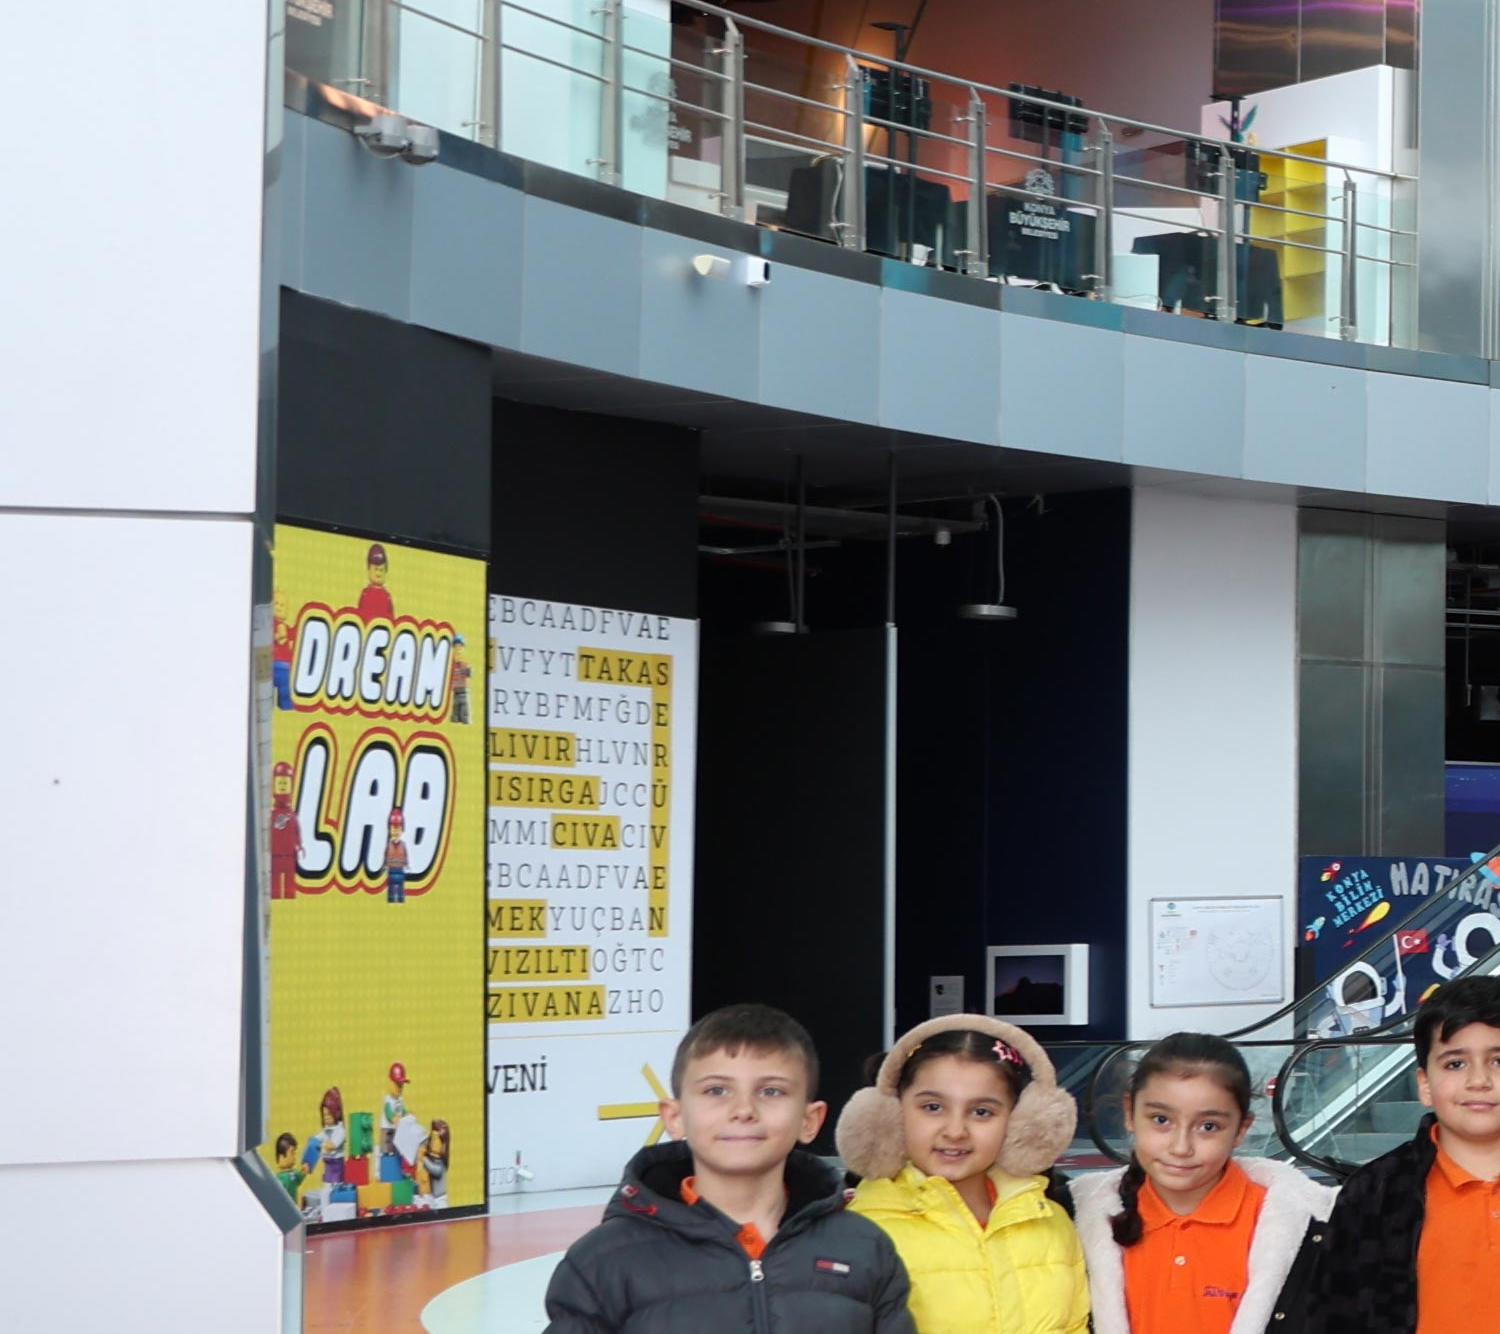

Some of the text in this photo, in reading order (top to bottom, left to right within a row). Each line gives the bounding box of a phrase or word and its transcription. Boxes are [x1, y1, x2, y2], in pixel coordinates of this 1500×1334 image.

[293, 615, 451, 713] DREAM
[296, 736, 449, 880] LAB
[1325, 869, 1369, 902] KONYA
[488, 1055, 547, 1095] VENİ
